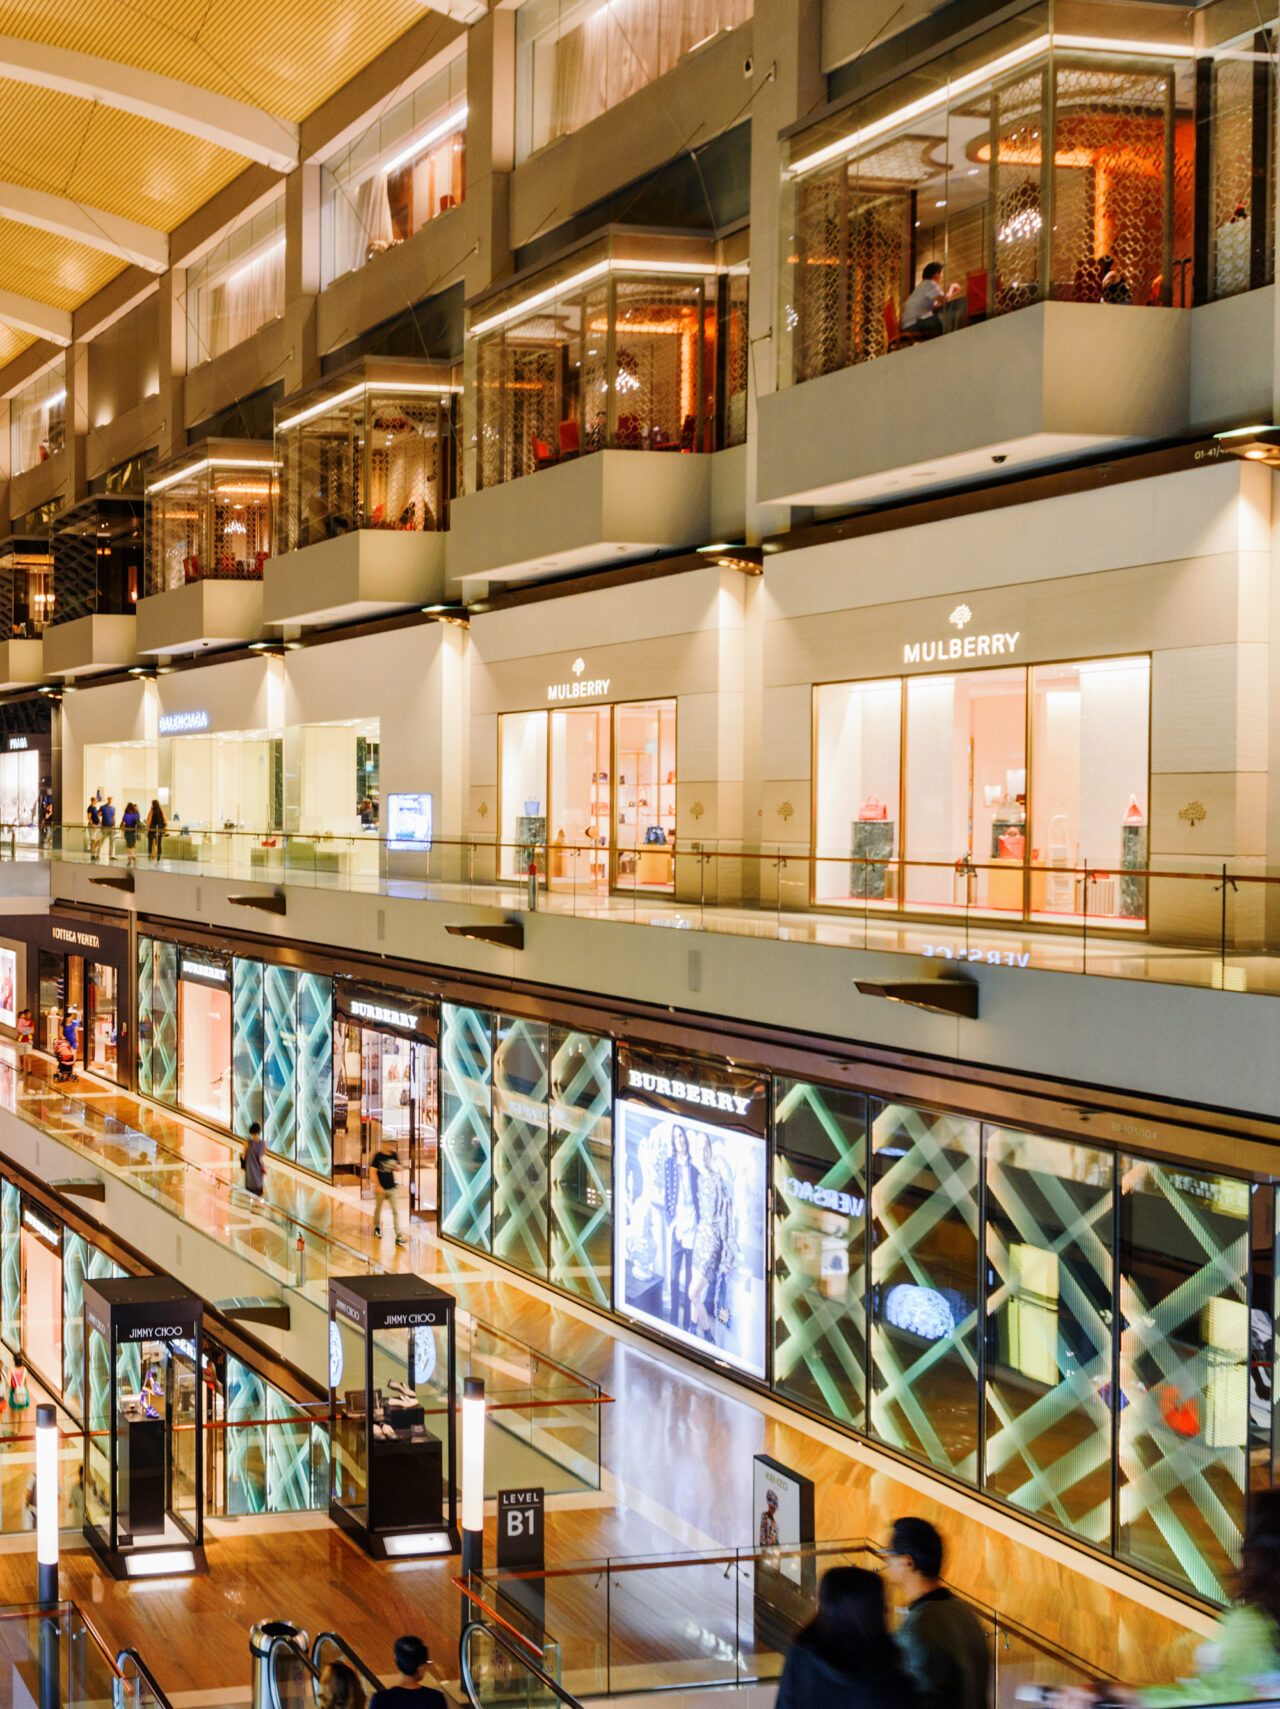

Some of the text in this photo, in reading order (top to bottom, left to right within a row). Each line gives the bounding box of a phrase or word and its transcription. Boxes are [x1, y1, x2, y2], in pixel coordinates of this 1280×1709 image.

[903, 631, 1020, 664] MULBERRY
[548, 679, 610, 701] MULBERRY
[159, 710, 209, 733] BALENCIAGA
[52, 927, 100, 949] BOTTEGA VENETA
[182, 960, 228, 981] BURBERRY
[350, 1000, 419, 1030] BURBERRY
[628, 1069, 751, 1116] BURBERRY
[384, 1313, 436, 1325] JIMMY CHOO
[129, 1326, 183, 1339] JIMMY CHOO
[503, 1492, 540, 1505] LEVEL
[507, 1509, 535, 1537] B1
